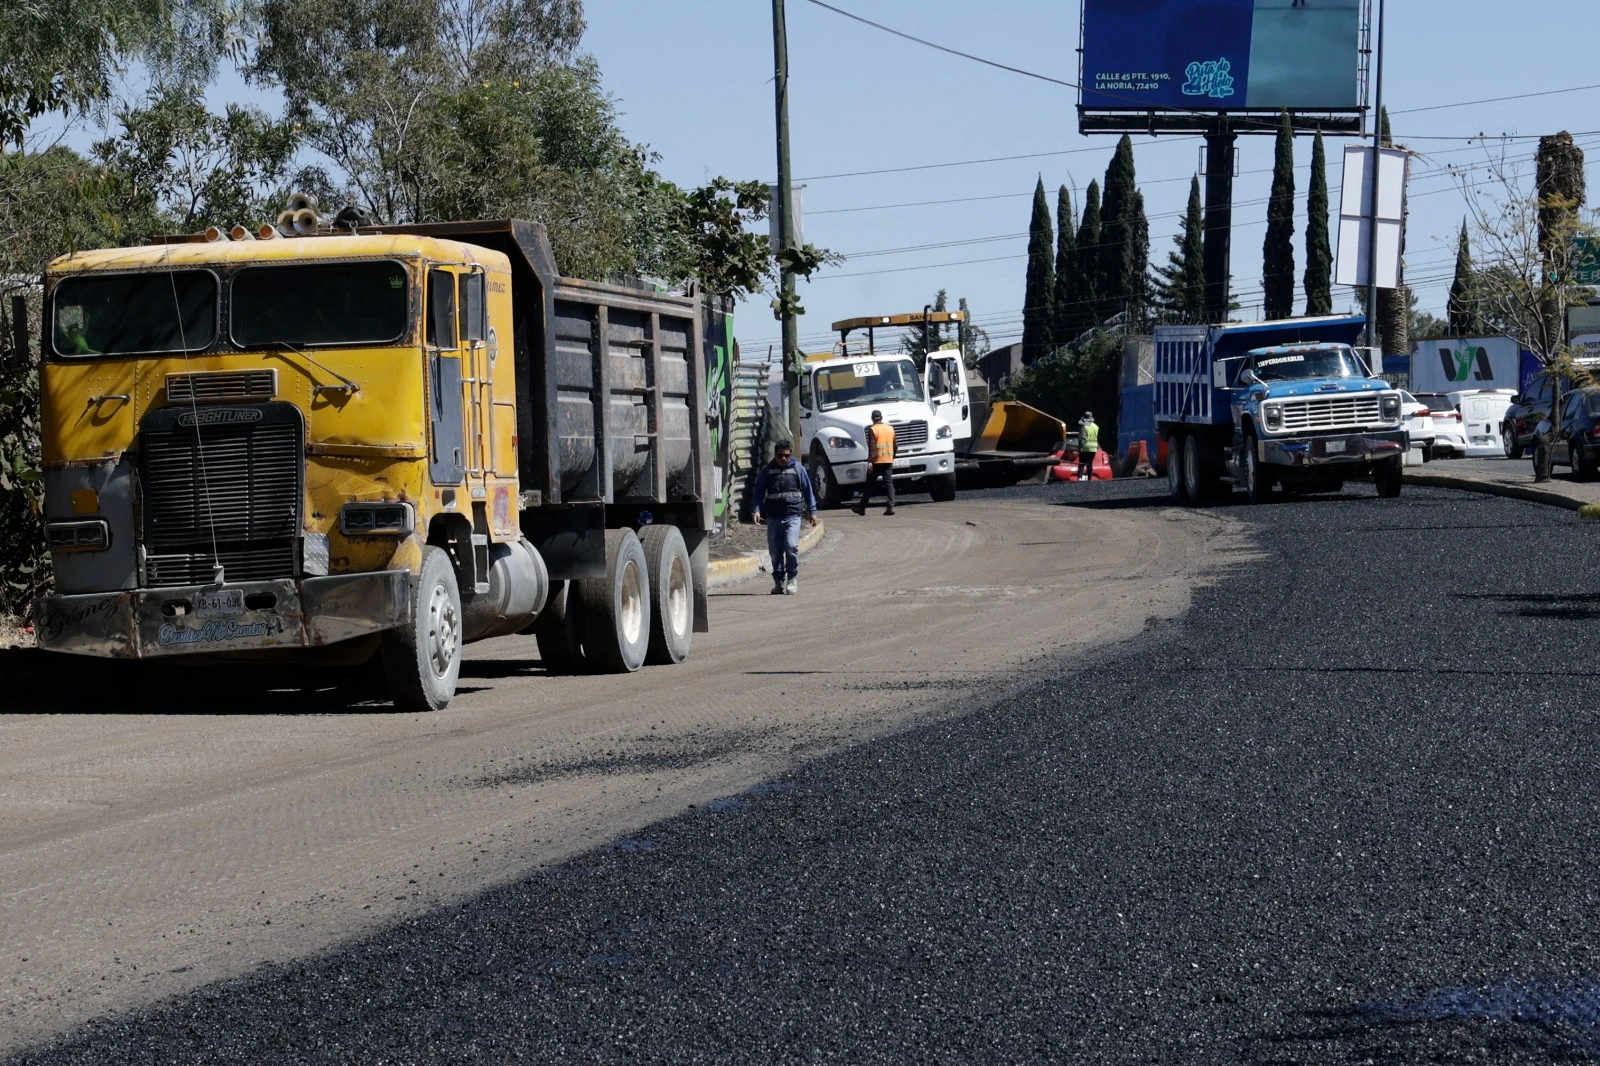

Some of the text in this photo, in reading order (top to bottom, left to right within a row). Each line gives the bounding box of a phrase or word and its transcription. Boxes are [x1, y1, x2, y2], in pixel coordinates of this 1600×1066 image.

[1095, 72, 1171, 81] CALLE 45 PTE. 1910,
[1095, 82, 1159, 91] LA NORIA, 72410
[1257, 355, 1305, 368] IMPERDONABLES
[855, 363, 876, 374] 937
[182, 410, 258, 425] FREIGHTLINER
